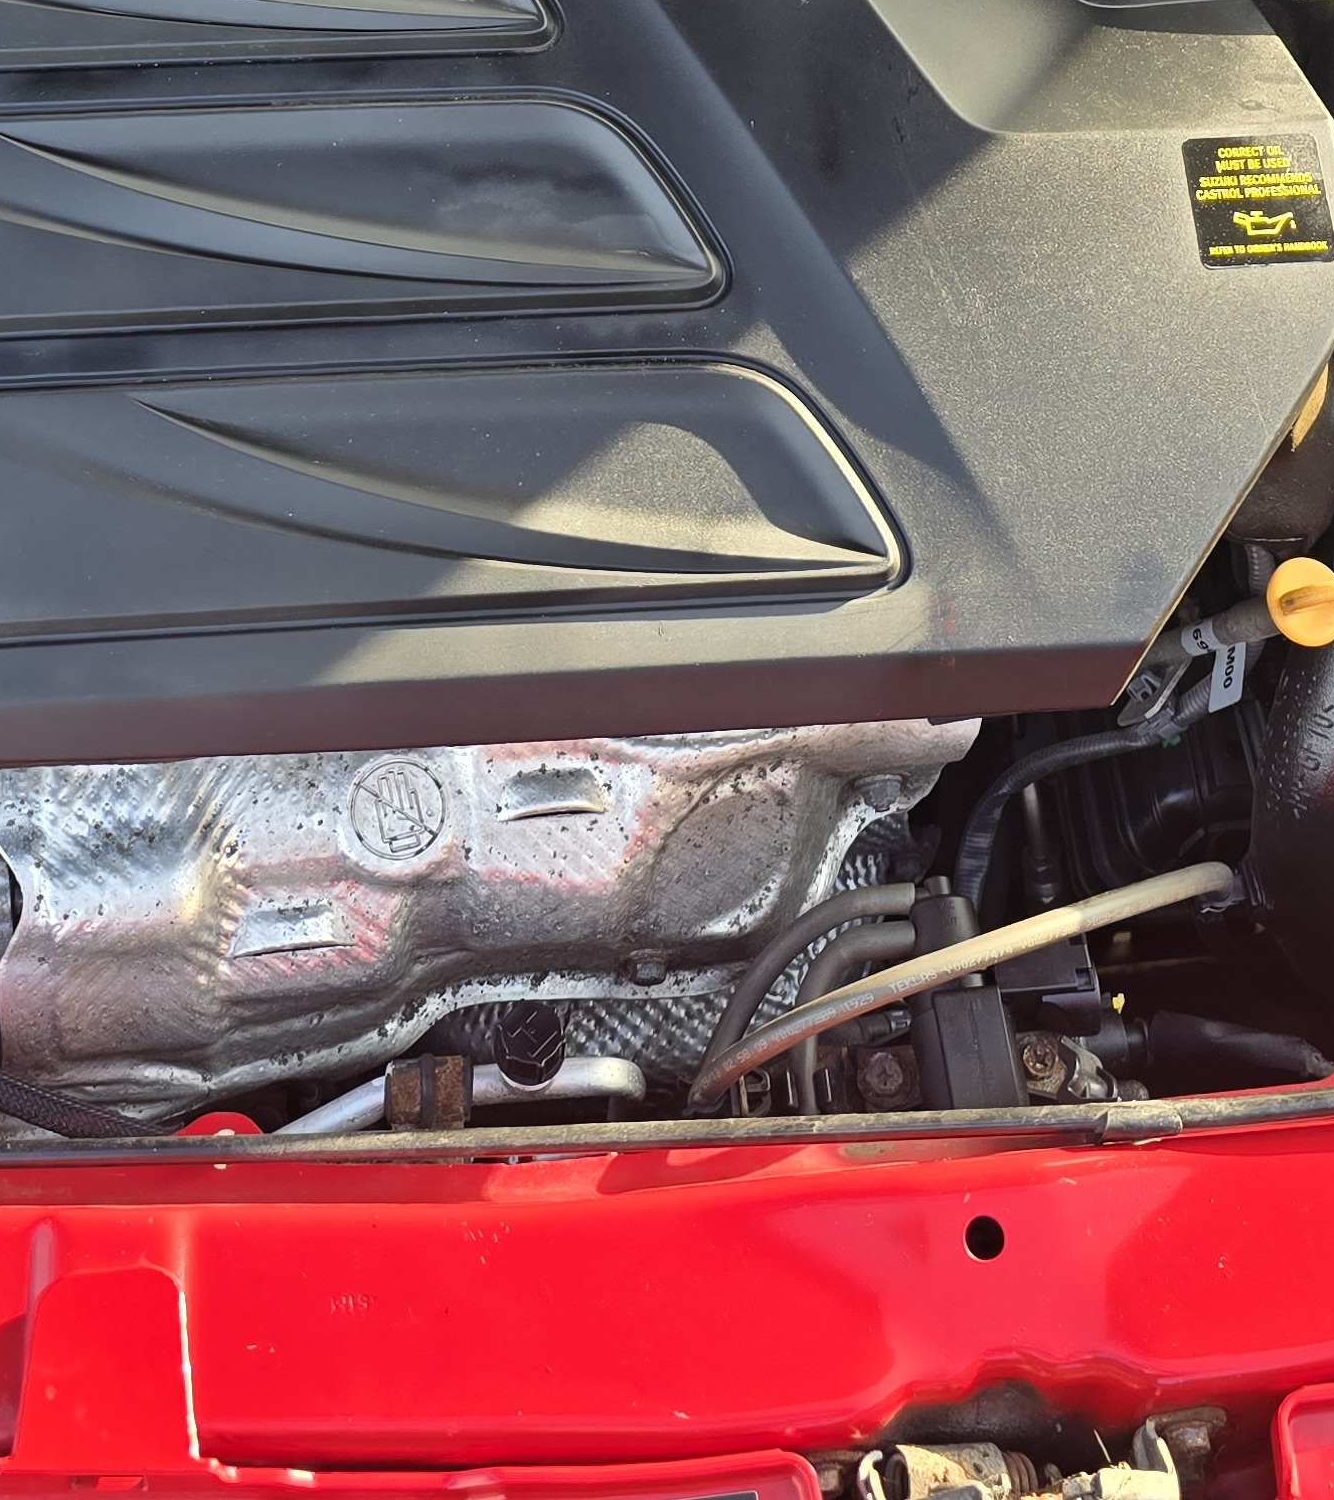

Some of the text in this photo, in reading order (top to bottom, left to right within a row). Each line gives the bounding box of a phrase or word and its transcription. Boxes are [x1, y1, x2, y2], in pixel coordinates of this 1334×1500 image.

[1218, 146, 1284, 158] CORRECT OIL
[1215, 158, 1290, 171] MUST BE USED
[1199, 173, 1312, 187] SUZUKI RECOMMENDS
[1196, 184, 1321, 200] CASTROL PROFESSIONAL
[1235, 245, 1245, 254] TO
[887, 968, 939, 995] TEKLAS
